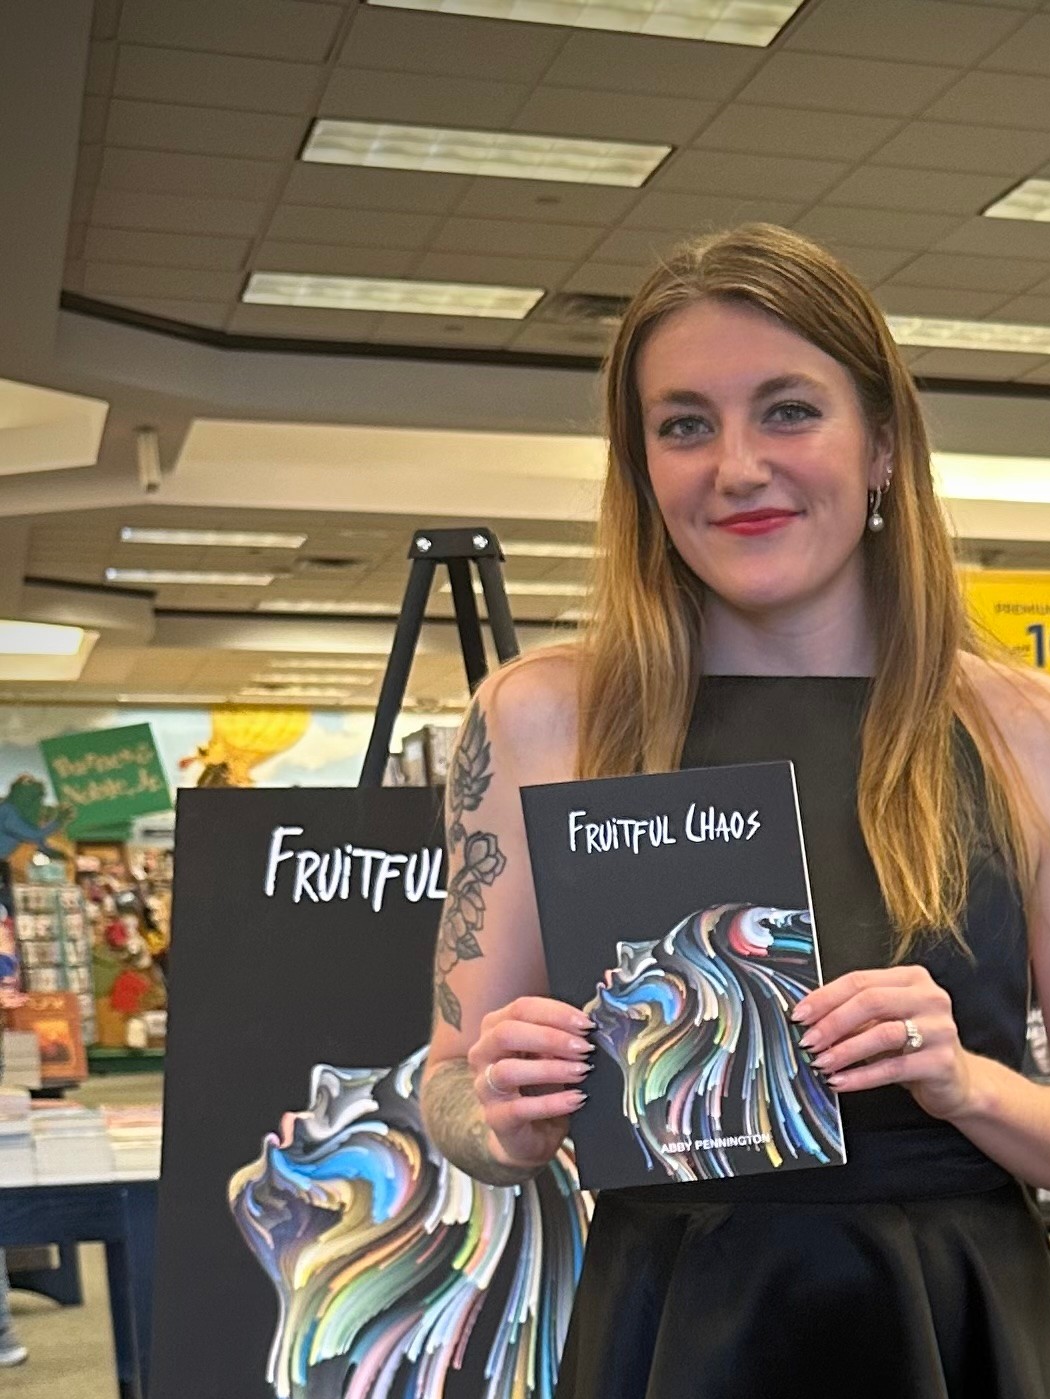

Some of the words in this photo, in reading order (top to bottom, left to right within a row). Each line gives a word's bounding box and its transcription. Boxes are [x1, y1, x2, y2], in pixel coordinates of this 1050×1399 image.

[685, 803, 761, 843] CHAOS
[660, 1140, 692, 1154] ABBY
[694, 1133, 772, 1151] PENNINGTON
